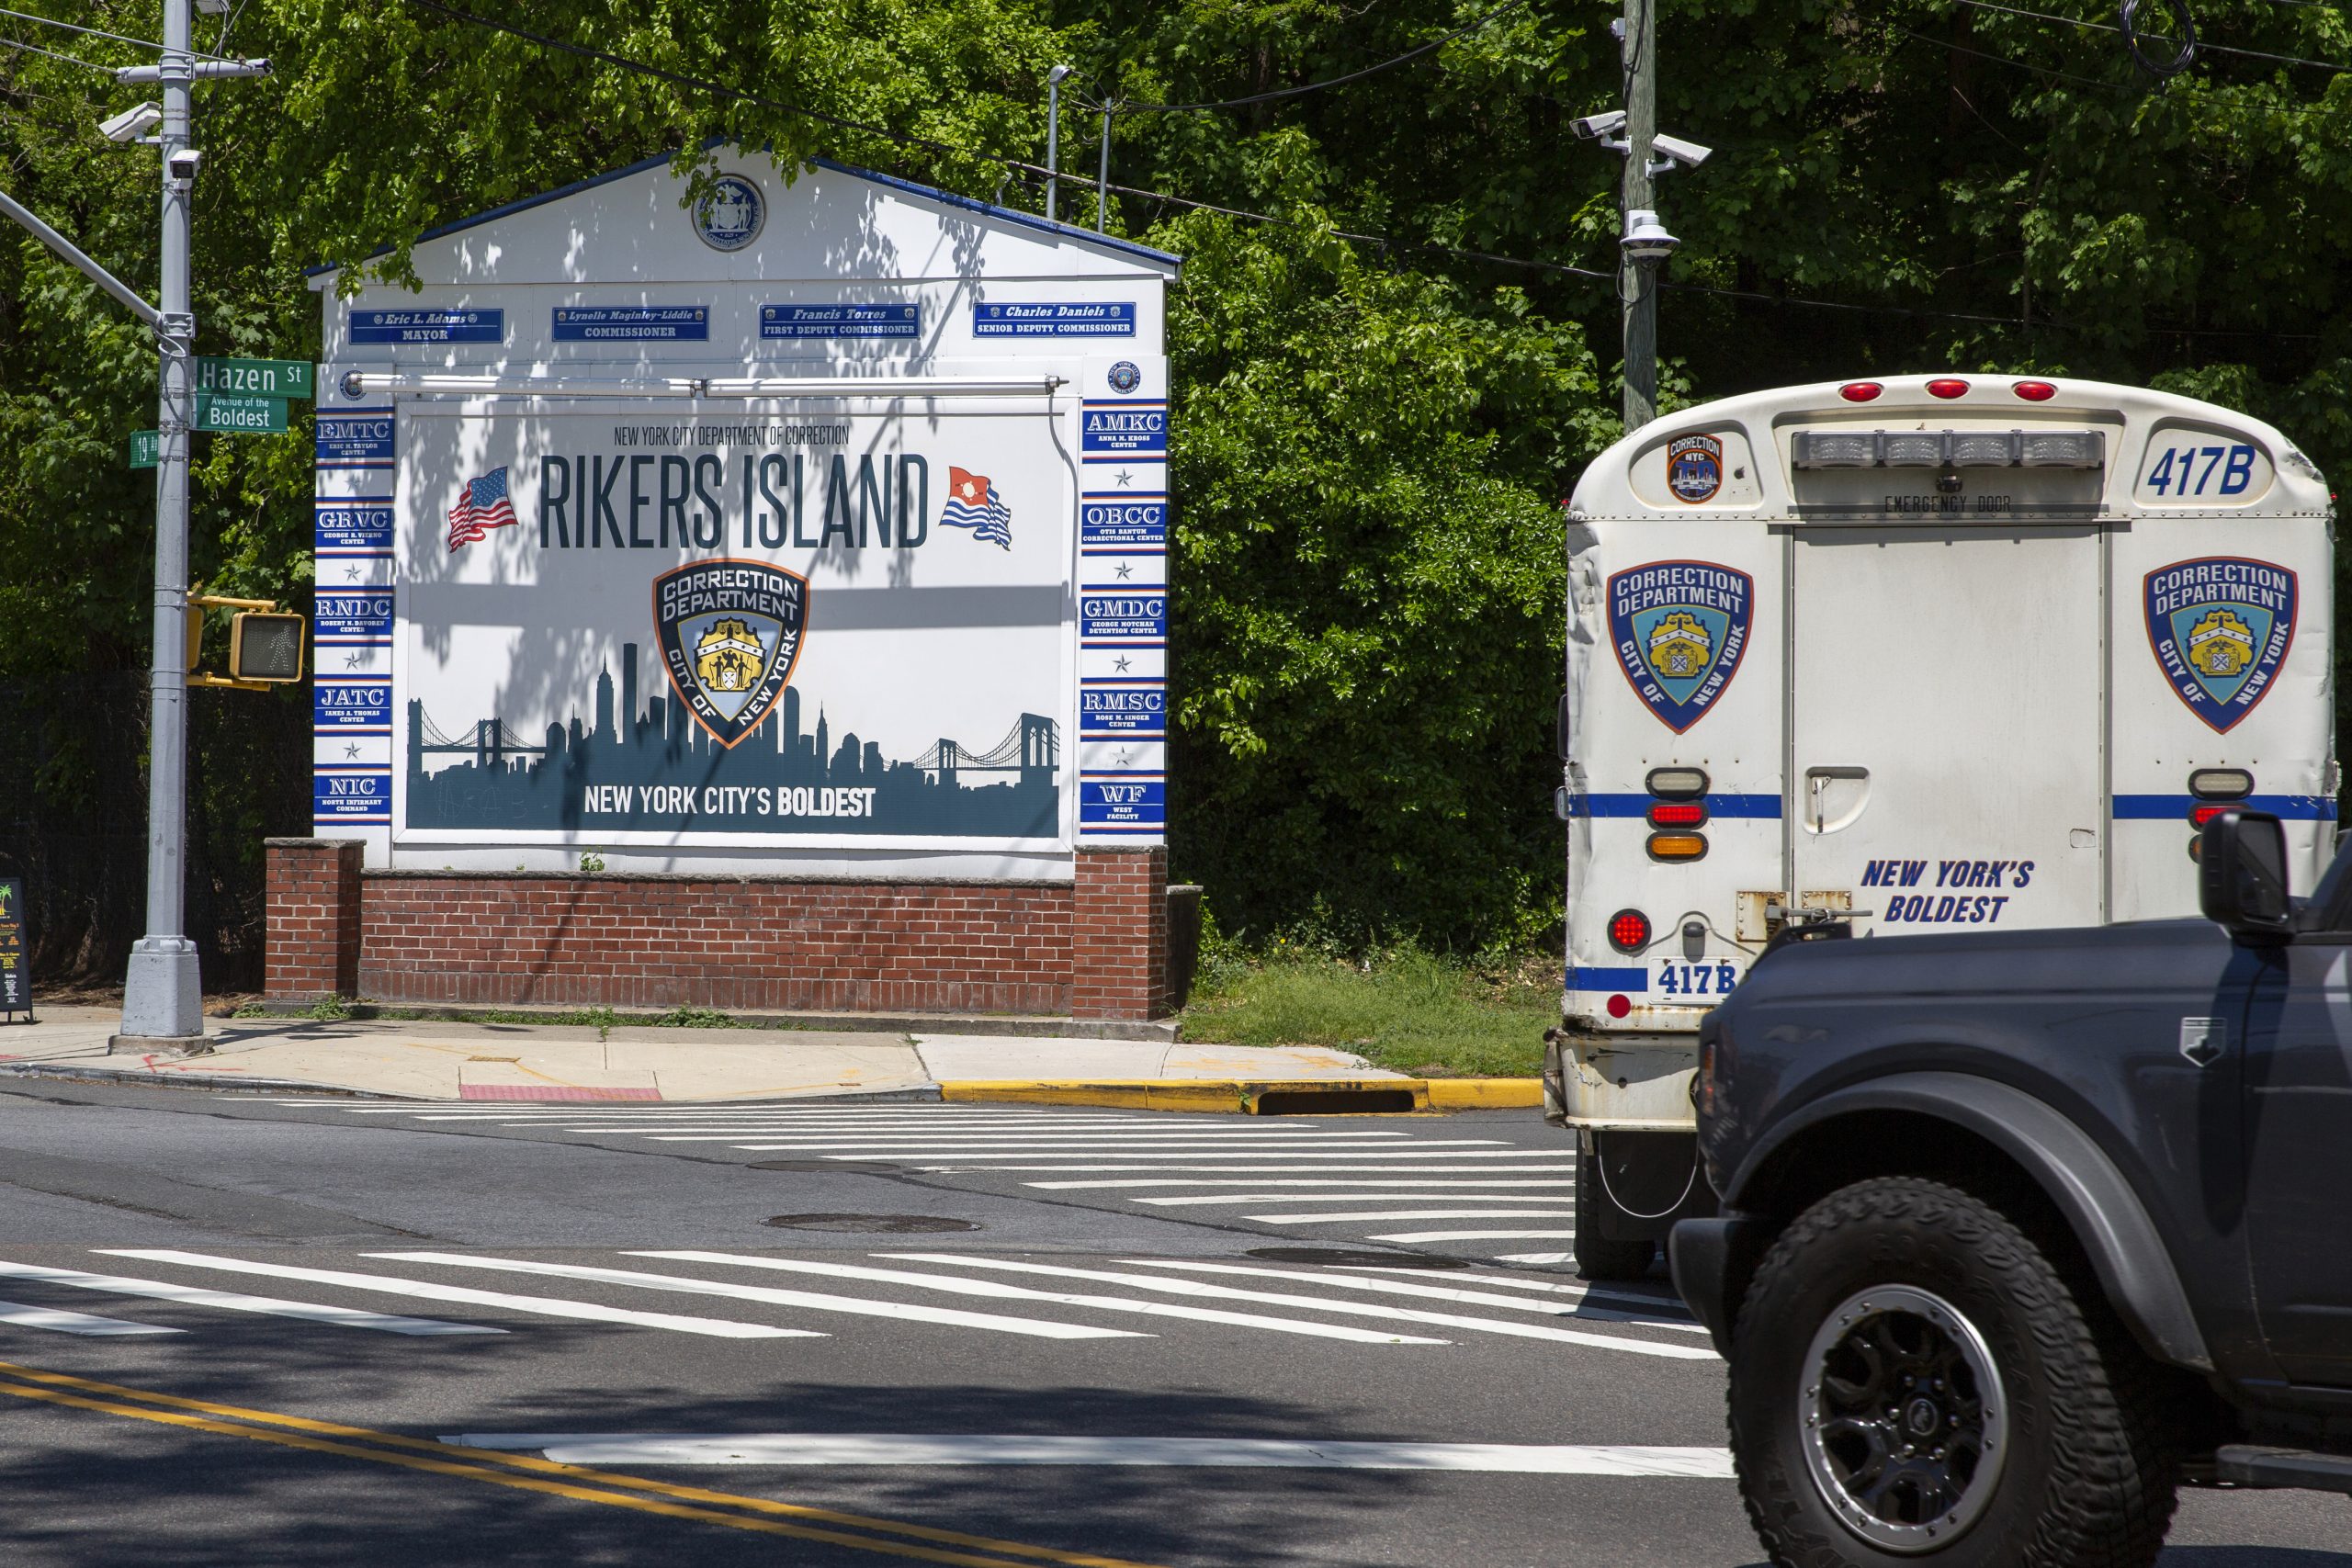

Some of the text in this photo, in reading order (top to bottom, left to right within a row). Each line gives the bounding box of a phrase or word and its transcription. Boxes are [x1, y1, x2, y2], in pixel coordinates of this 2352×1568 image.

[384, 314, 466, 324] Eric L. Adams
[569, 309, 693, 321] Lynelle Maginley-Liddie
[792, 309, 886, 320] Francis Torres
[1005, 305, 1105, 317] Charles Daniels
[402, 330, 448, 340] MAYOR
[584, 327, 676, 337] COMMISSIONER
[764, 325, 915, 334] FIRST DEPUTY COMMISSIONER
[978, 323, 1131, 333] SENIOR DEPUTY COMMISSIONER
[202, 362, 301, 391] Hazen St
[211, 397, 269, 408] Avenue of the
[210, 408, 270, 427] Boldest
[1087, 413, 1162, 432] AMKC
[318, 422, 390, 439] EMTC
[614, 425, 850, 446] NEW YORK CITY DEPARTMENT OF CORRECTION
[138, 436, 147, 463] 19
[1670, 435, 1720, 457] CORRECTION
[1685, 452, 1705, 461] NYC
[2147, 445, 2256, 496] 417B
[539, 454, 930, 549] RIKERS ISLAND
[1885, 496, 2011, 513] EMERGENCY DOOR
[318, 511, 388, 527] GRVC
[1087, 507, 1159, 525] OBCC
[663, 570, 797, 603] CORRECTION
[1616, 568, 1743, 597] CORRECTION
[2154, 564, 2287, 595] CORRECTION
[316, 599, 390, 616] RNDC
[662, 590, 797, 623] DEPARTMENT
[1084, 599, 1163, 617] GMDC
[1618, 586, 1742, 617] DEPARTMENT
[2156, 582, 2286, 615] DEPARTMENT
[1621, 625, 1746, 706] CITY OF NEW YORK
[2159, 621, 2290, 705] CITY OF NEW YORK
[669, 628, 797, 727] CITY OF NEW YORK
[322, 689, 384, 705] JATC
[1084, 693, 1161, 711] RMSC
[329, 778, 377, 795] NIC
[1100, 784, 1146, 803] WF
[584, 785, 876, 818] NEW YORK CITY'S BOLDEST
[1860, 860, 2035, 888] NEW YORK'S
[1883, 895, 2009, 923] BOLDEST
[1657, 965, 1736, 994] 417B
